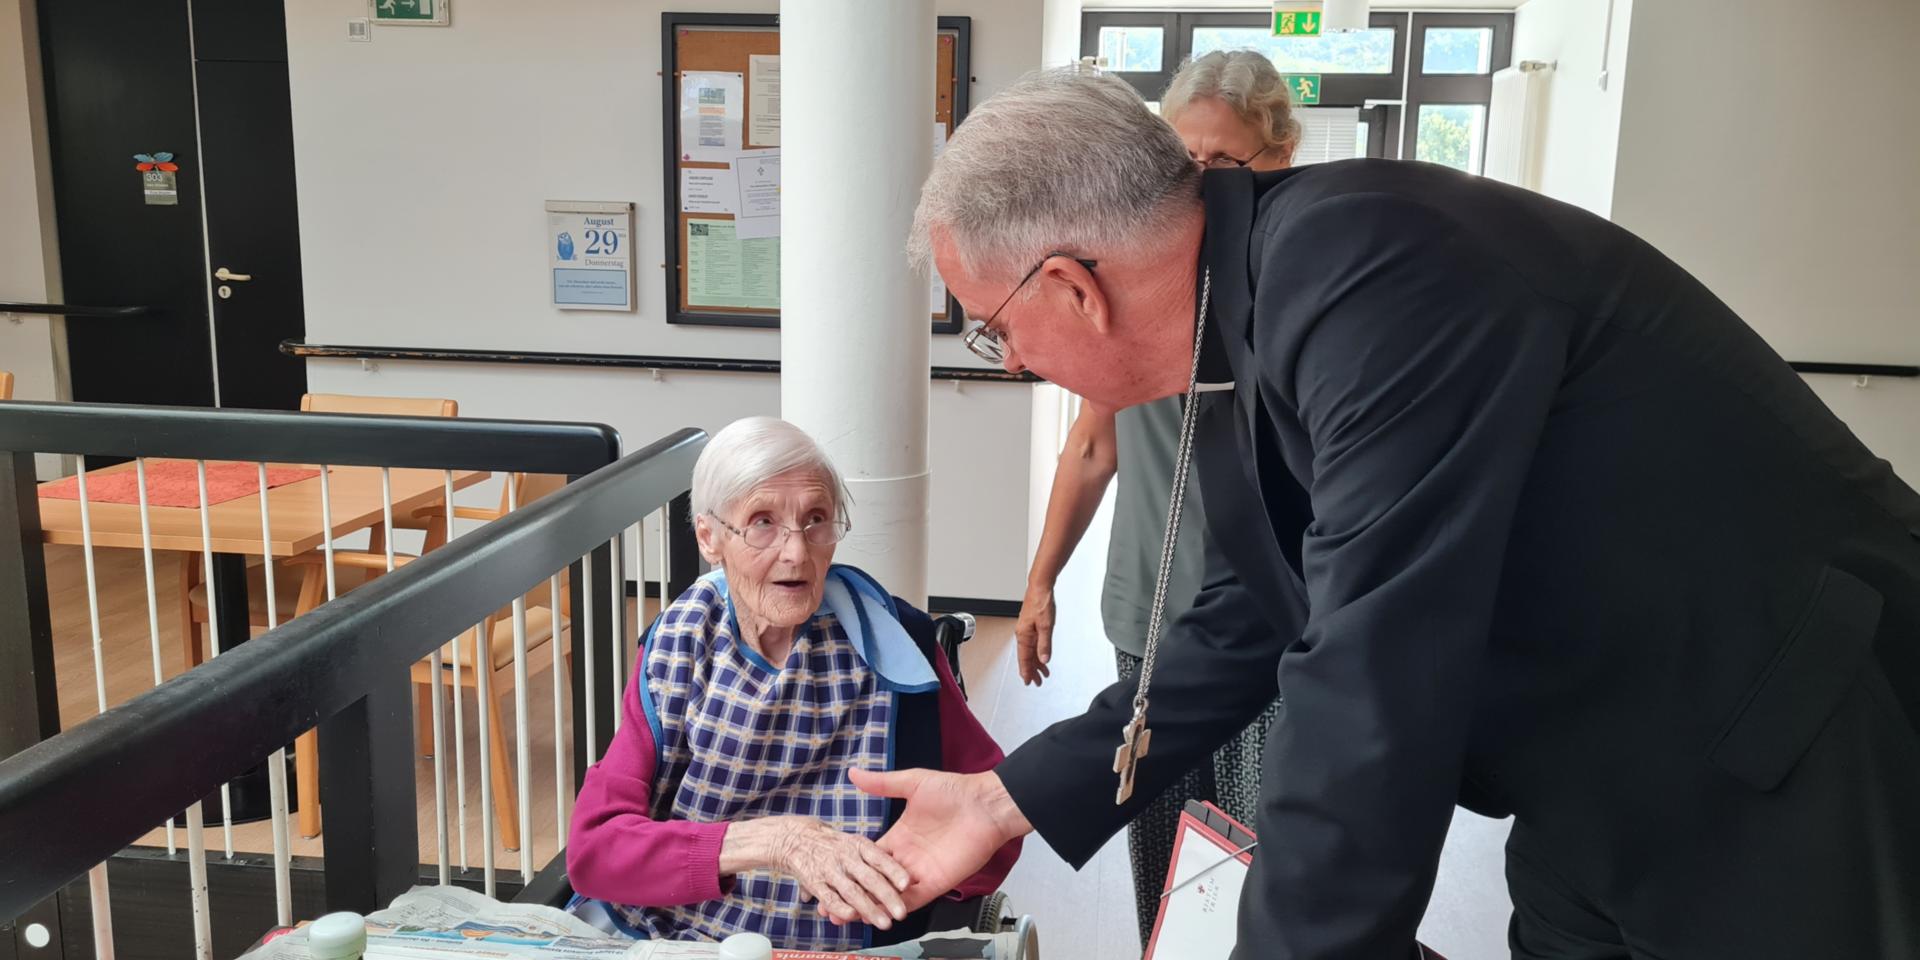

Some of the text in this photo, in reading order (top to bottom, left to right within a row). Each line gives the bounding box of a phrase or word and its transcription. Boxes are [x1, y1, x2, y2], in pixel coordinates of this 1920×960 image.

[584, 217, 614, 227] August
[585, 230, 618, 255] 29
[584, 259, 624, 268] Donnerstag
